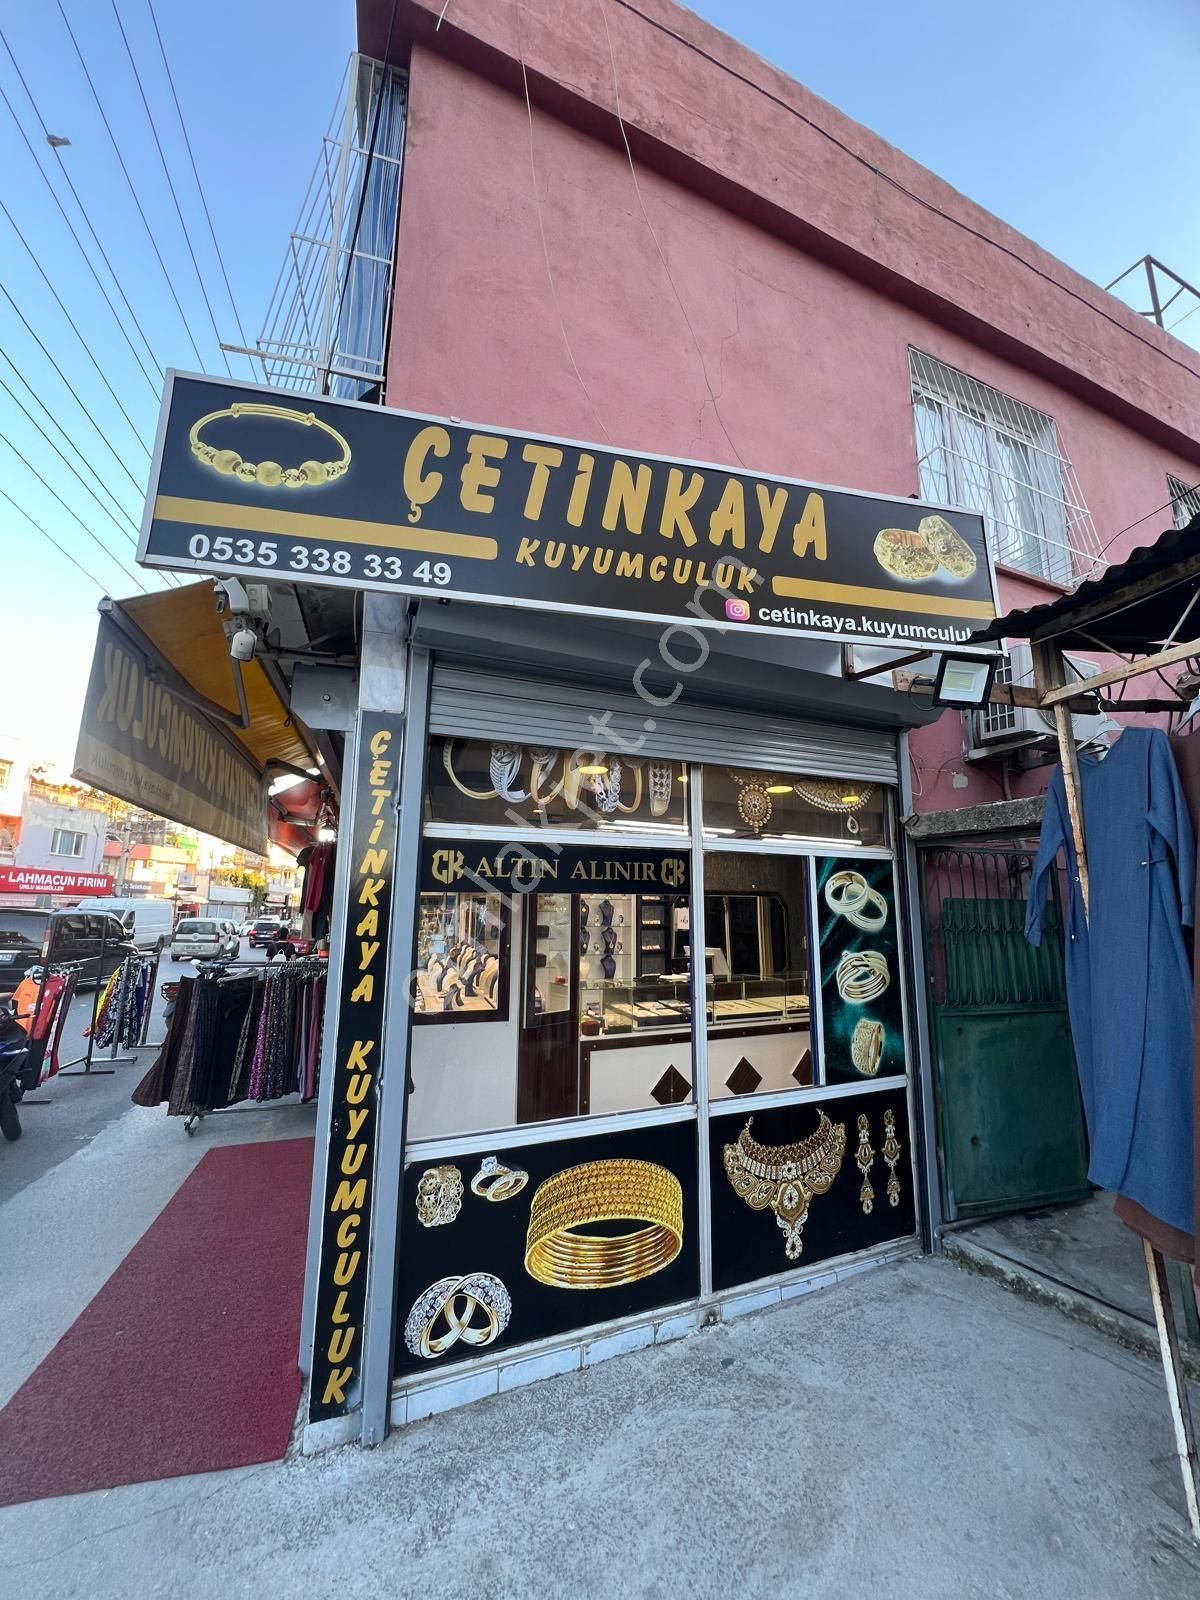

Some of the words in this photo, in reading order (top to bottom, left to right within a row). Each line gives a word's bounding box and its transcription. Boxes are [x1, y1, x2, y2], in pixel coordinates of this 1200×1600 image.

[403, 426, 827, 561] ÇETİNKAYA
[188, 533, 278, 567] 0535
[289, 545, 352, 575] 338
[363, 555, 403, 581] 33
[412, 560, 452, 585] 49
[515, 537, 757, 594] KUYUMCULUK
[8, 871, 75, 886] LAHMACUN
[77, 877, 107, 888] FIRINI
[350, 730, 392, 1002] ÇETİNKAYA
[474, 857, 560, 879] ALTIN
[570, 860, 661, 881] ALINIR
[322, 1040, 374, 1404] KUYUMCULUK
